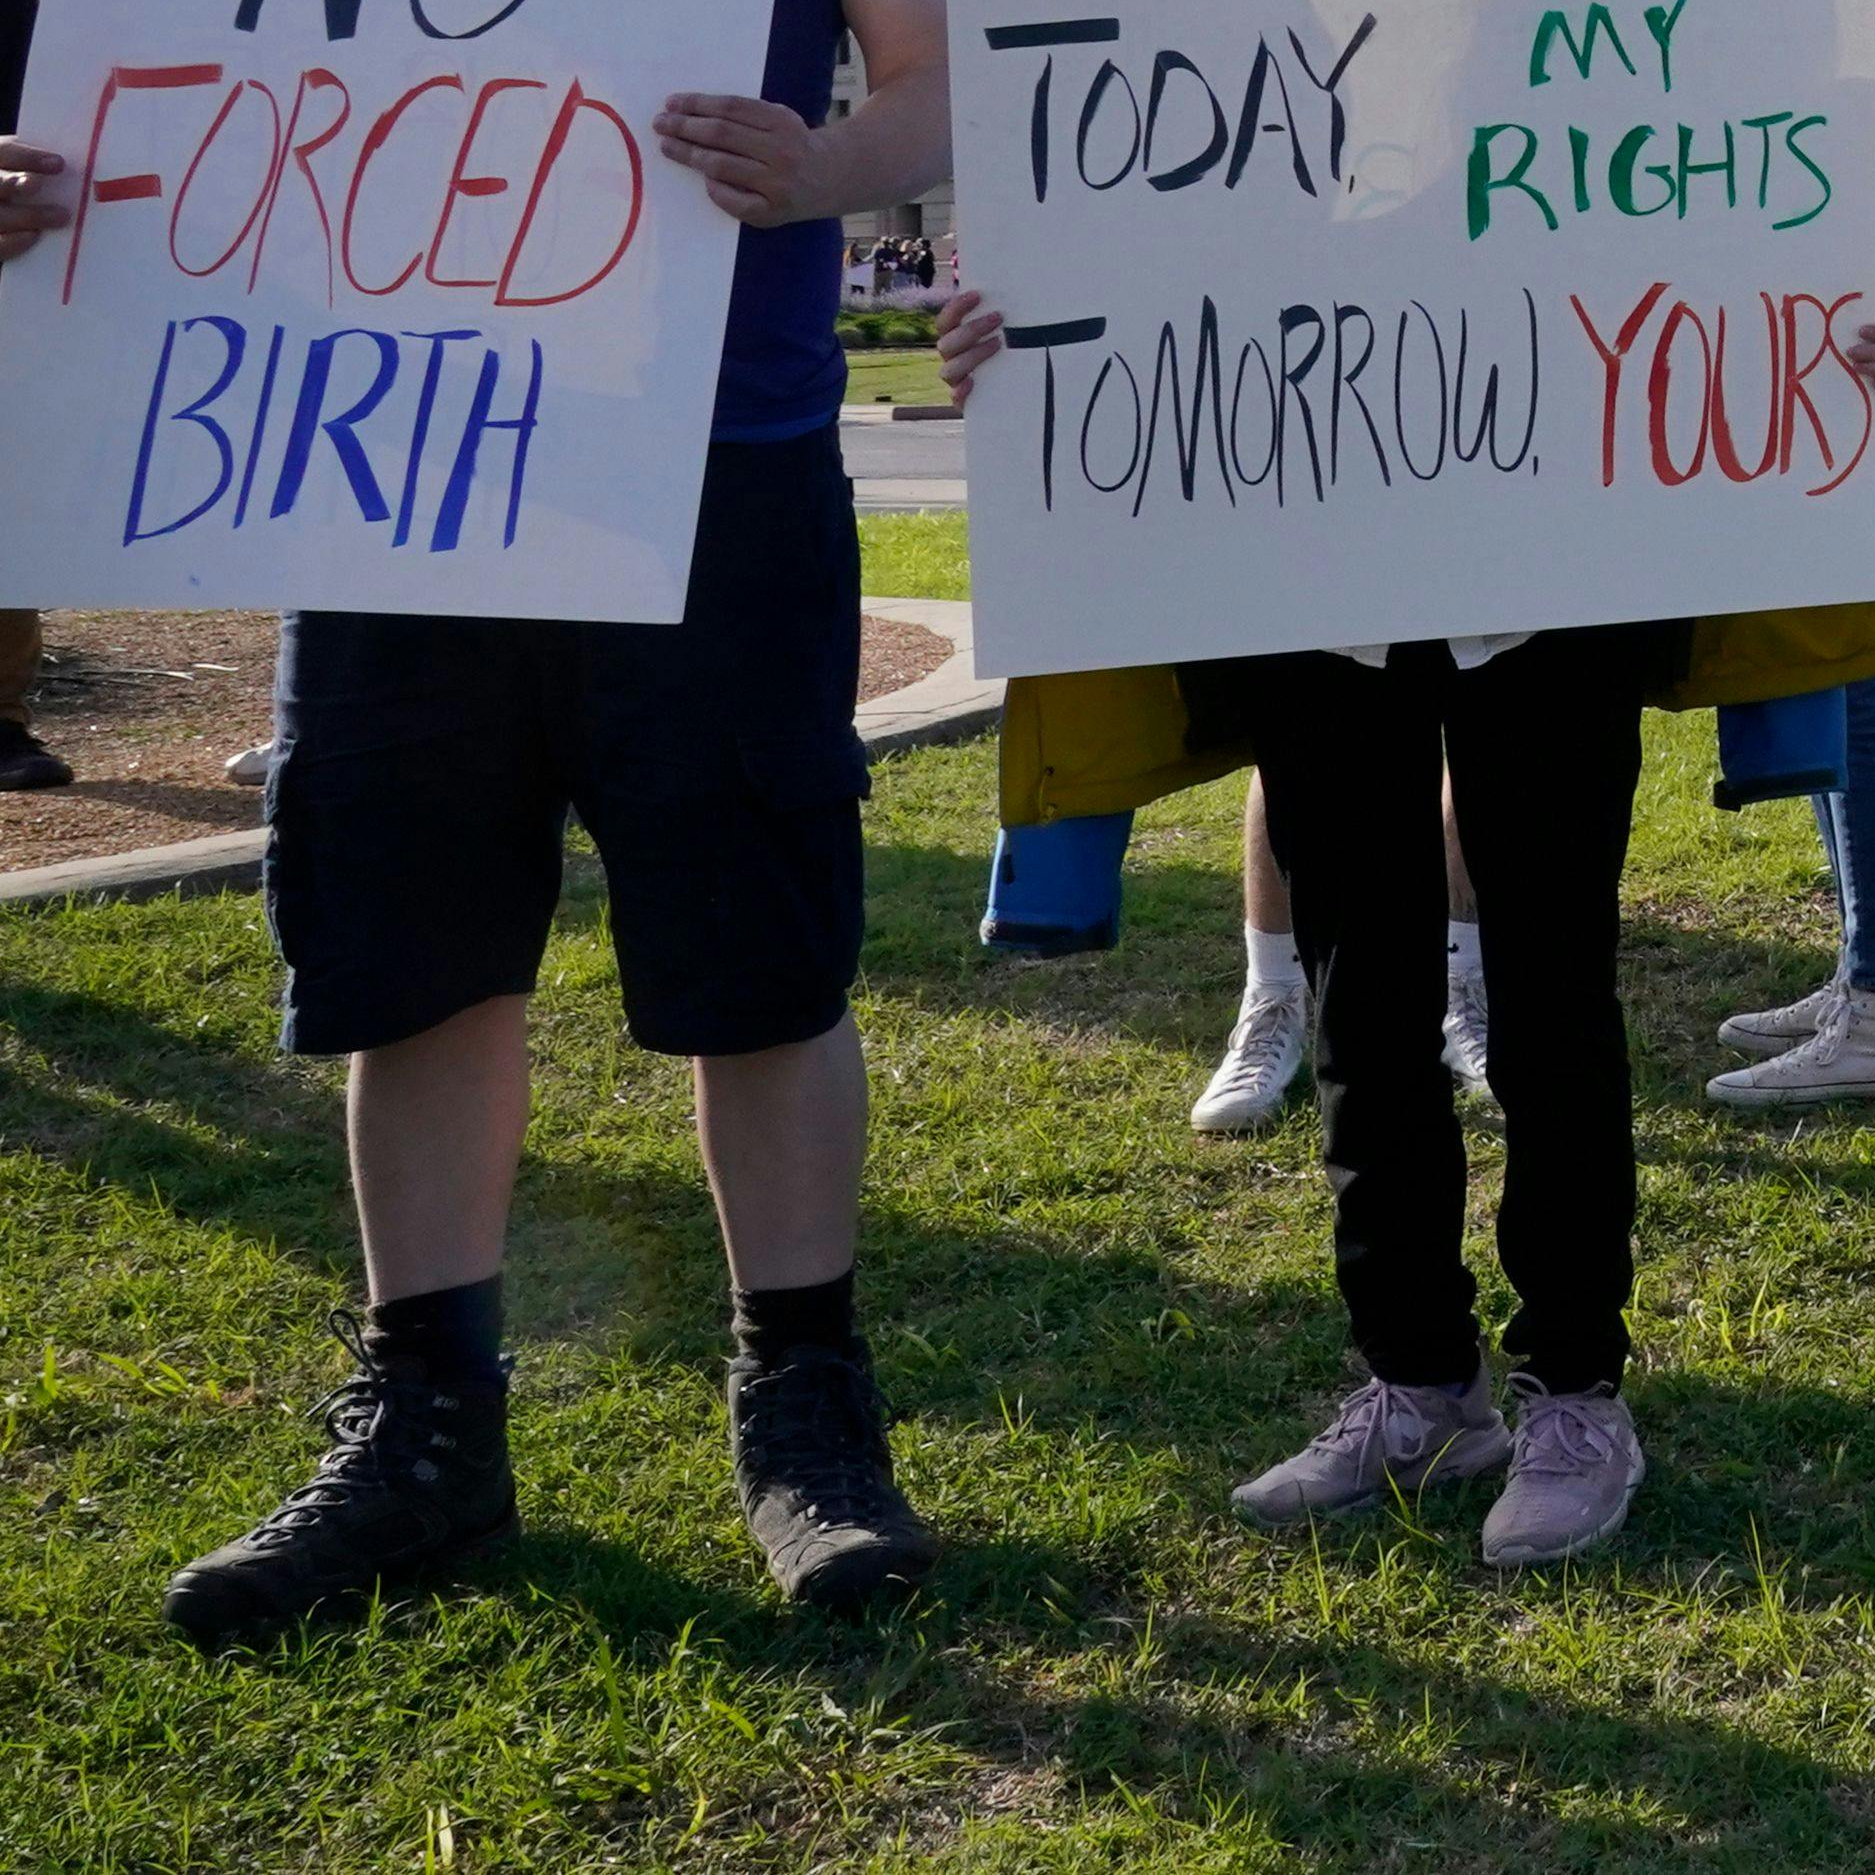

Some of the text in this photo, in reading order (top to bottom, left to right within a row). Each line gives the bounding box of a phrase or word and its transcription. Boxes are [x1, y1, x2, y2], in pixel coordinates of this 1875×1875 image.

[61, 62, 643, 309] FORCED
[1467, 111, 1833, 241] RIGHTS
[122, 315, 543, 553] BIRTH
[1569, 282, 1873, 497] YOURS
